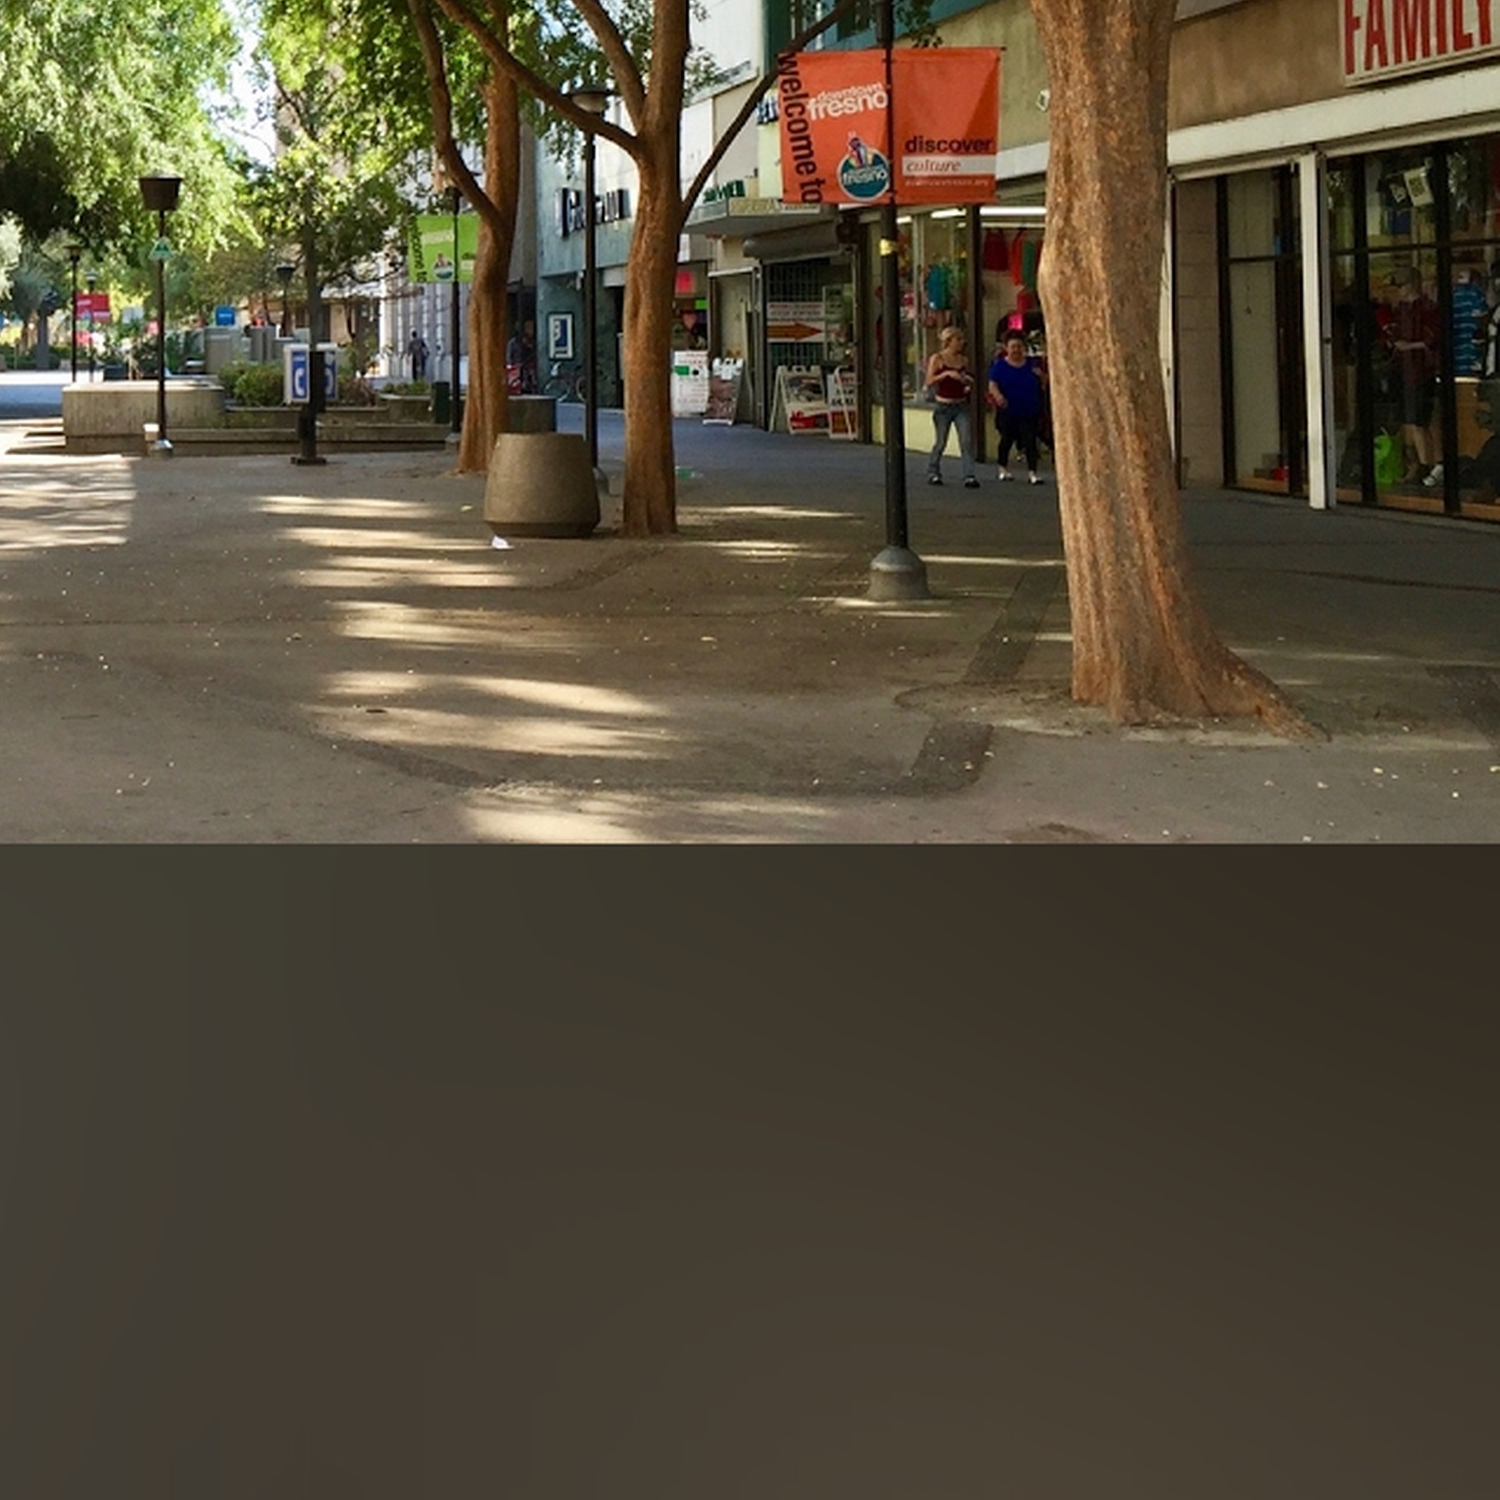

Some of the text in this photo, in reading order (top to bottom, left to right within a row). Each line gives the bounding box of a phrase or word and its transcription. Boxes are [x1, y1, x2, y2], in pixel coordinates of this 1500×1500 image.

[807, 90, 889, 121] fresno
[778, 52, 826, 204] welcome to
[904, 135, 993, 154] discover
[905, 155, 961, 173] culture
